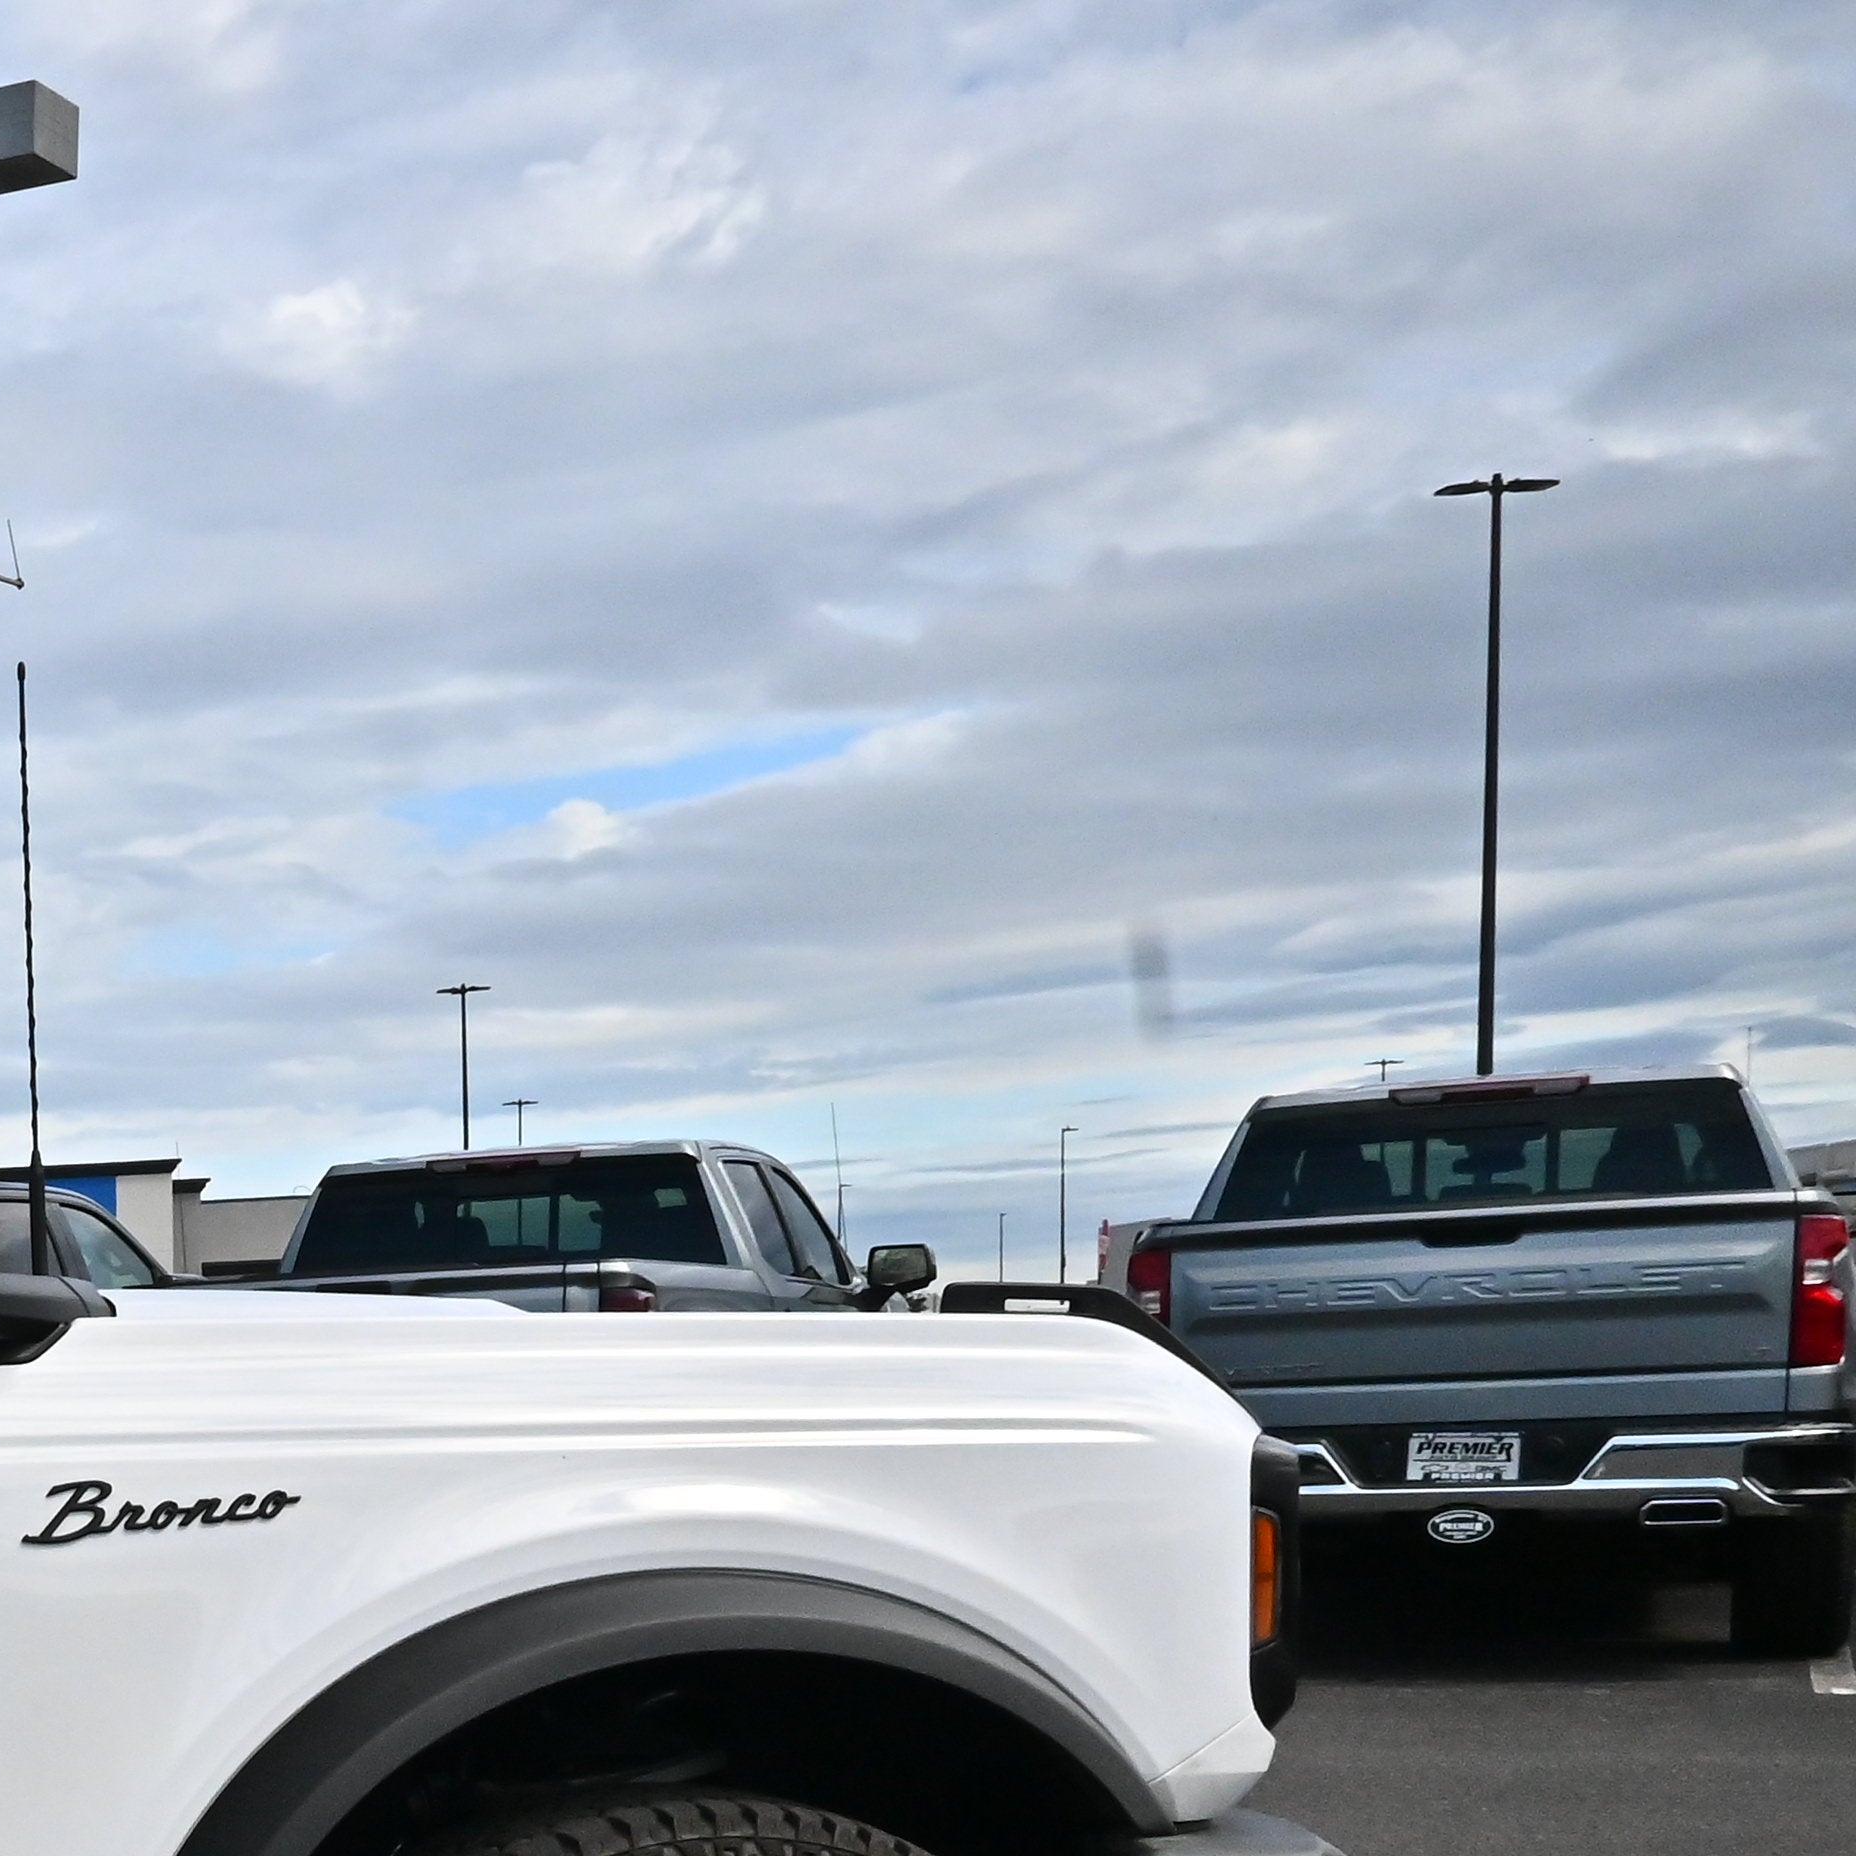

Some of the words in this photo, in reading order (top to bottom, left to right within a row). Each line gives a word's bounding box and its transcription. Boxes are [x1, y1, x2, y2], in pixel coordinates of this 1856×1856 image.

[1208, 1260, 1746, 1311] CHEVROLET
[1415, 1441, 1514, 1462] PREMIER
[20, 1479, 302, 1544] Bronco
